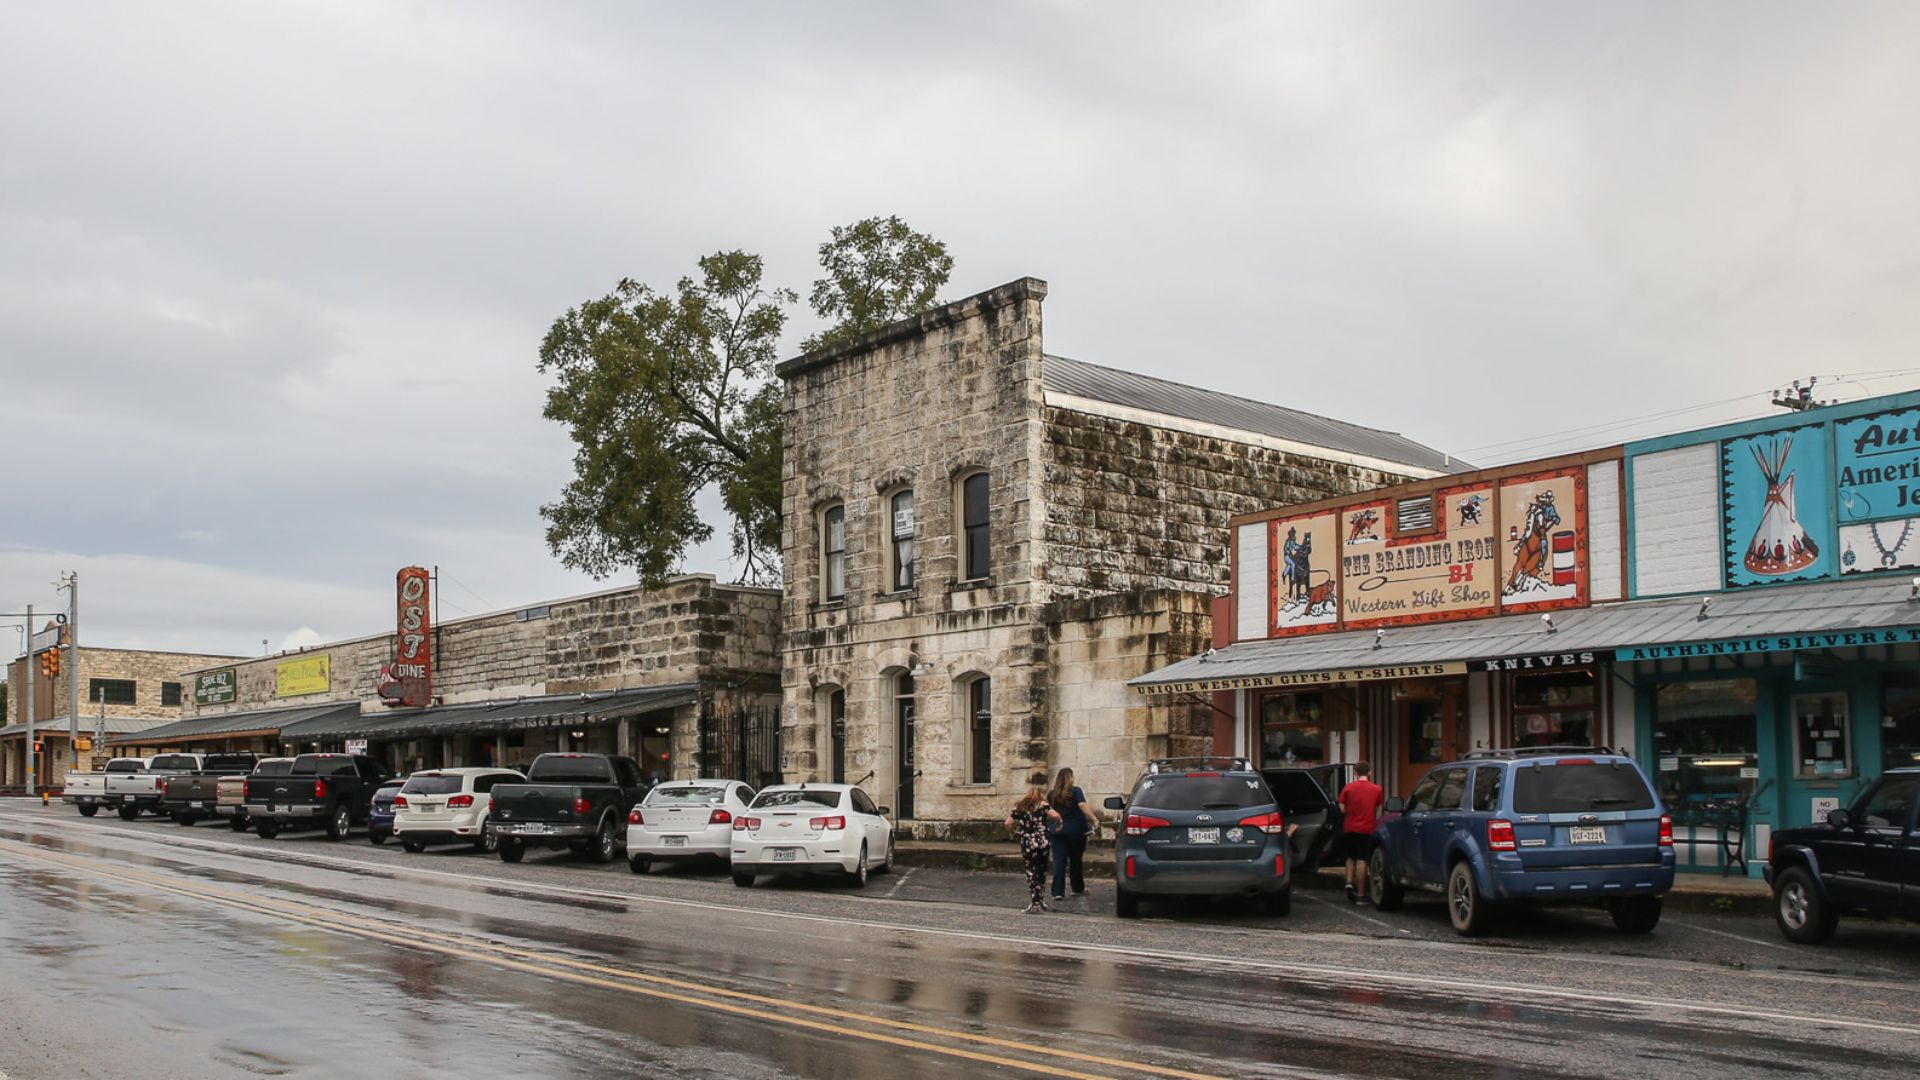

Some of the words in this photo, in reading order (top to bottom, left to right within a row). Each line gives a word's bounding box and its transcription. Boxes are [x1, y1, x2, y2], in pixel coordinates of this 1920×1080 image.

[1838, 457, 1920, 488] Ameri
[1343, 553, 1371, 577] THE
[1375, 542, 1452, 574] BRANDING
[1457, 536, 1495, 563] IRON
[1345, 596, 1407, 614] Western
[1411, 588, 1446, 609] Gift
[1451, 584, 1491, 605] Shop
[1632, 639, 1769, 659] AUTHENTIC
[1778, 632, 1877, 649] SILVER
[1884, 630, 1897, 642] &
[398, 664, 426, 679] DINE
[1485, 652, 1594, 671] KNIVES
[1137, 683, 1194, 695] UNIQUE
[1199, 676, 1274, 690] WESTERN
[1280, 672, 1331, 685] GIFTS
[1338, 671, 1347, 680] &
[1354, 664, 1445, 679] T-SHIRTS
